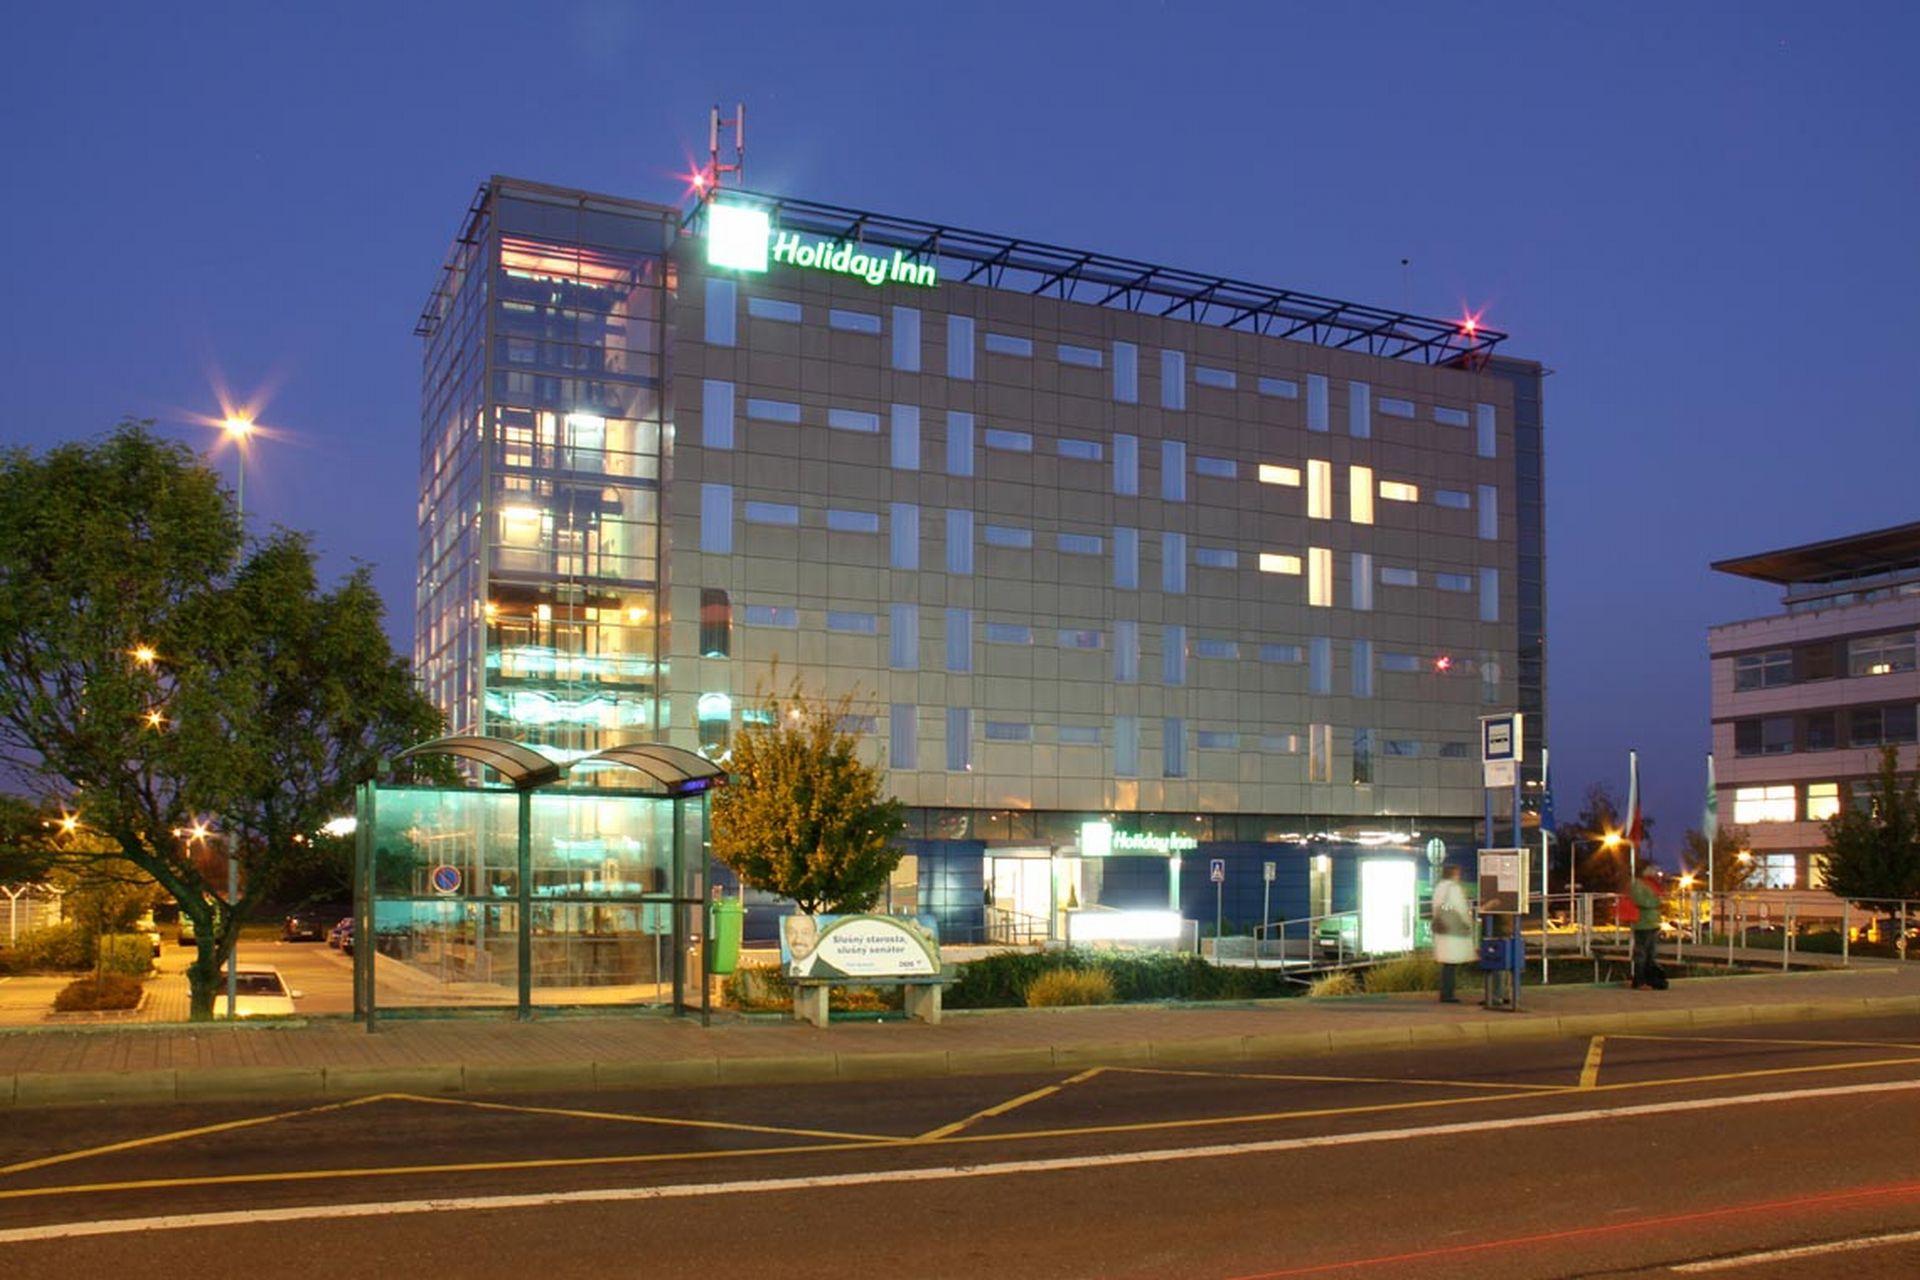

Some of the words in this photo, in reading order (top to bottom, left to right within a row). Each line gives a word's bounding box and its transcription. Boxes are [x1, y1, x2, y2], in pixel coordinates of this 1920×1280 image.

[773, 232, 888, 285] Holiday
[890, 250, 937, 287] Inn
[1113, 830, 1170, 853] Holiday
[1170, 830, 1198, 850] Inn
